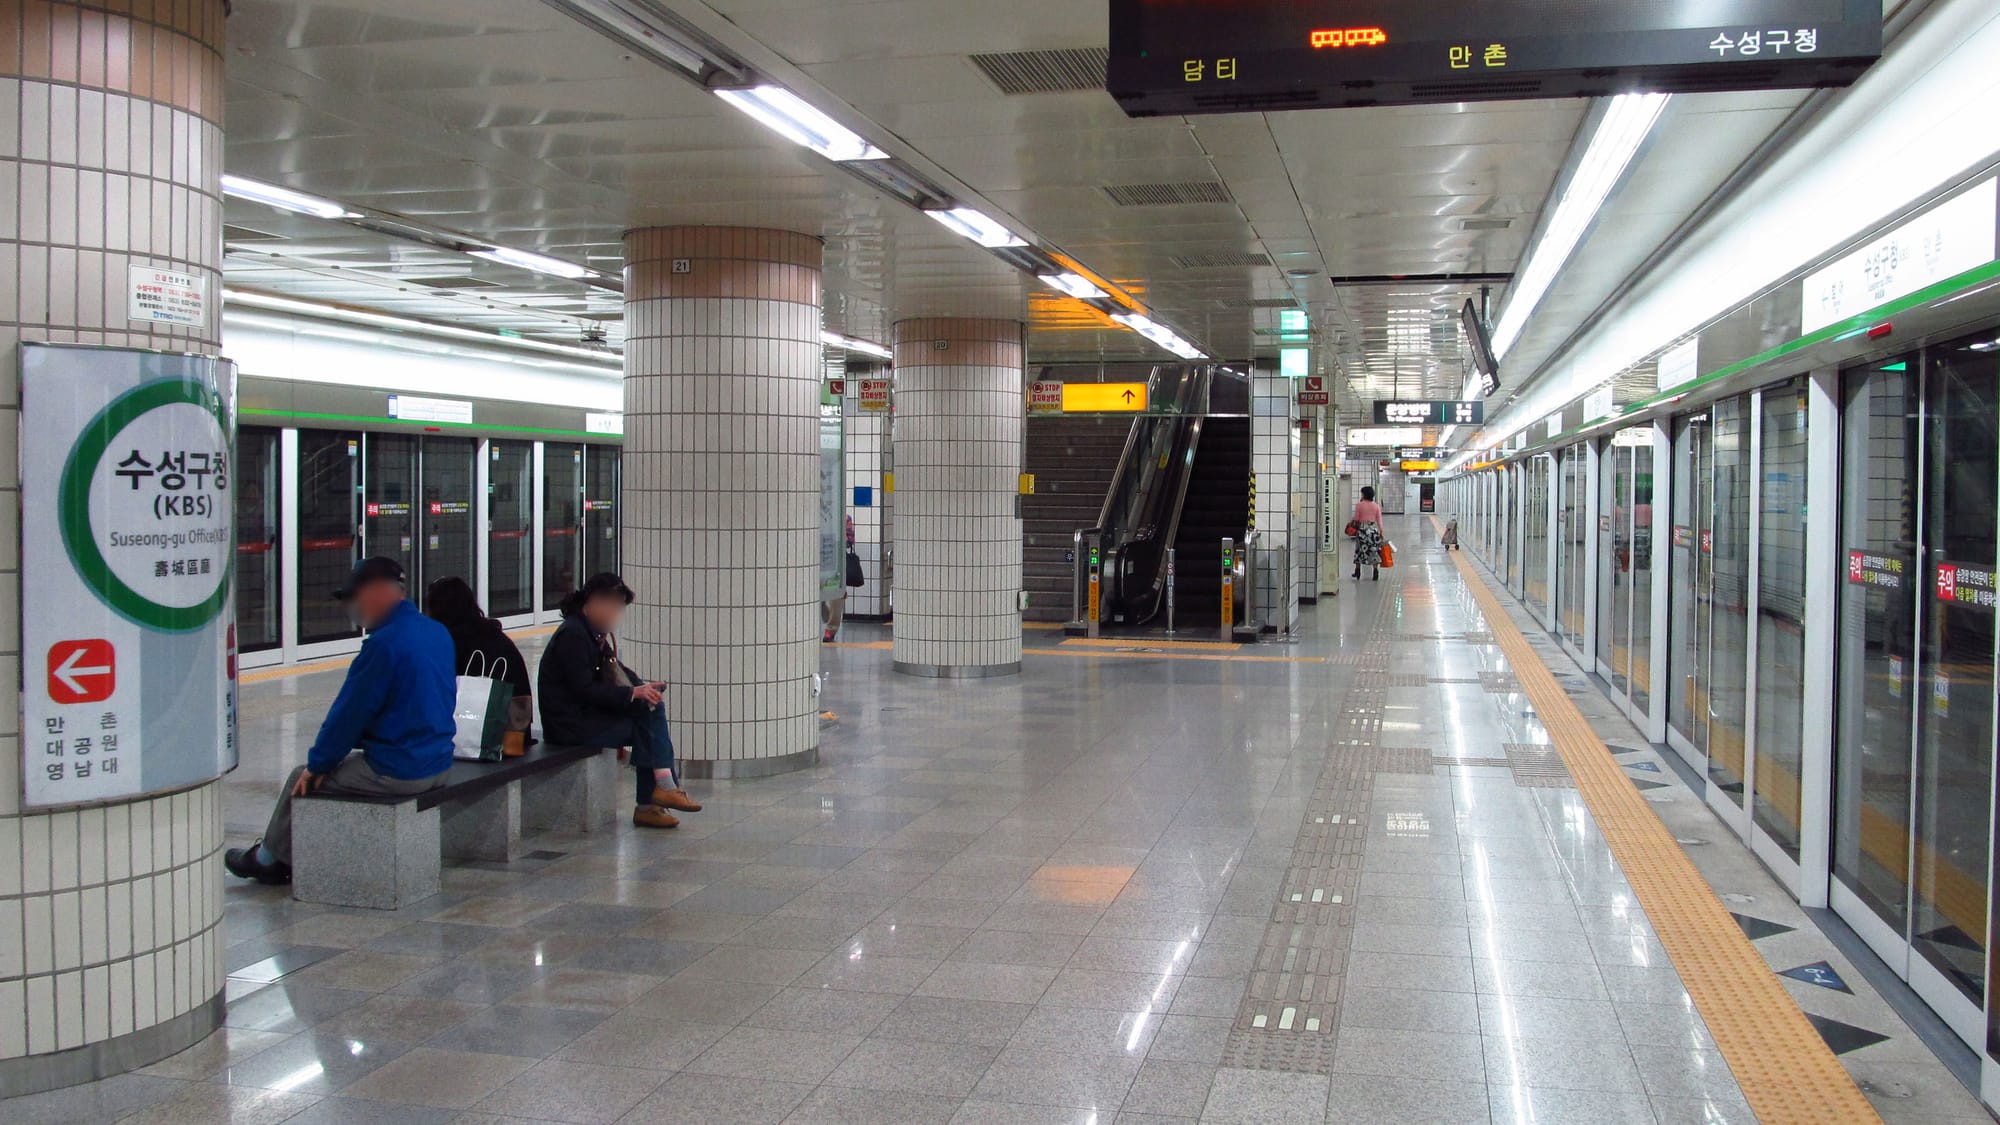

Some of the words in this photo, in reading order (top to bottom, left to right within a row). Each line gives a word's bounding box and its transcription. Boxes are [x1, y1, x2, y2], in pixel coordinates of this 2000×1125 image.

[1709, 28, 1817, 56] 수성구청
[675, 261, 687, 271] 21
[115, 450, 228, 490] 수성구청
[153, 494, 213, 520] (KBS)
[110, 531, 186, 549] Suseong-gu
[1850, 556, 1862, 579] 주의
[1938, 569, 1954, 597] 주의
[46, 757, 118, 781] 영남대
